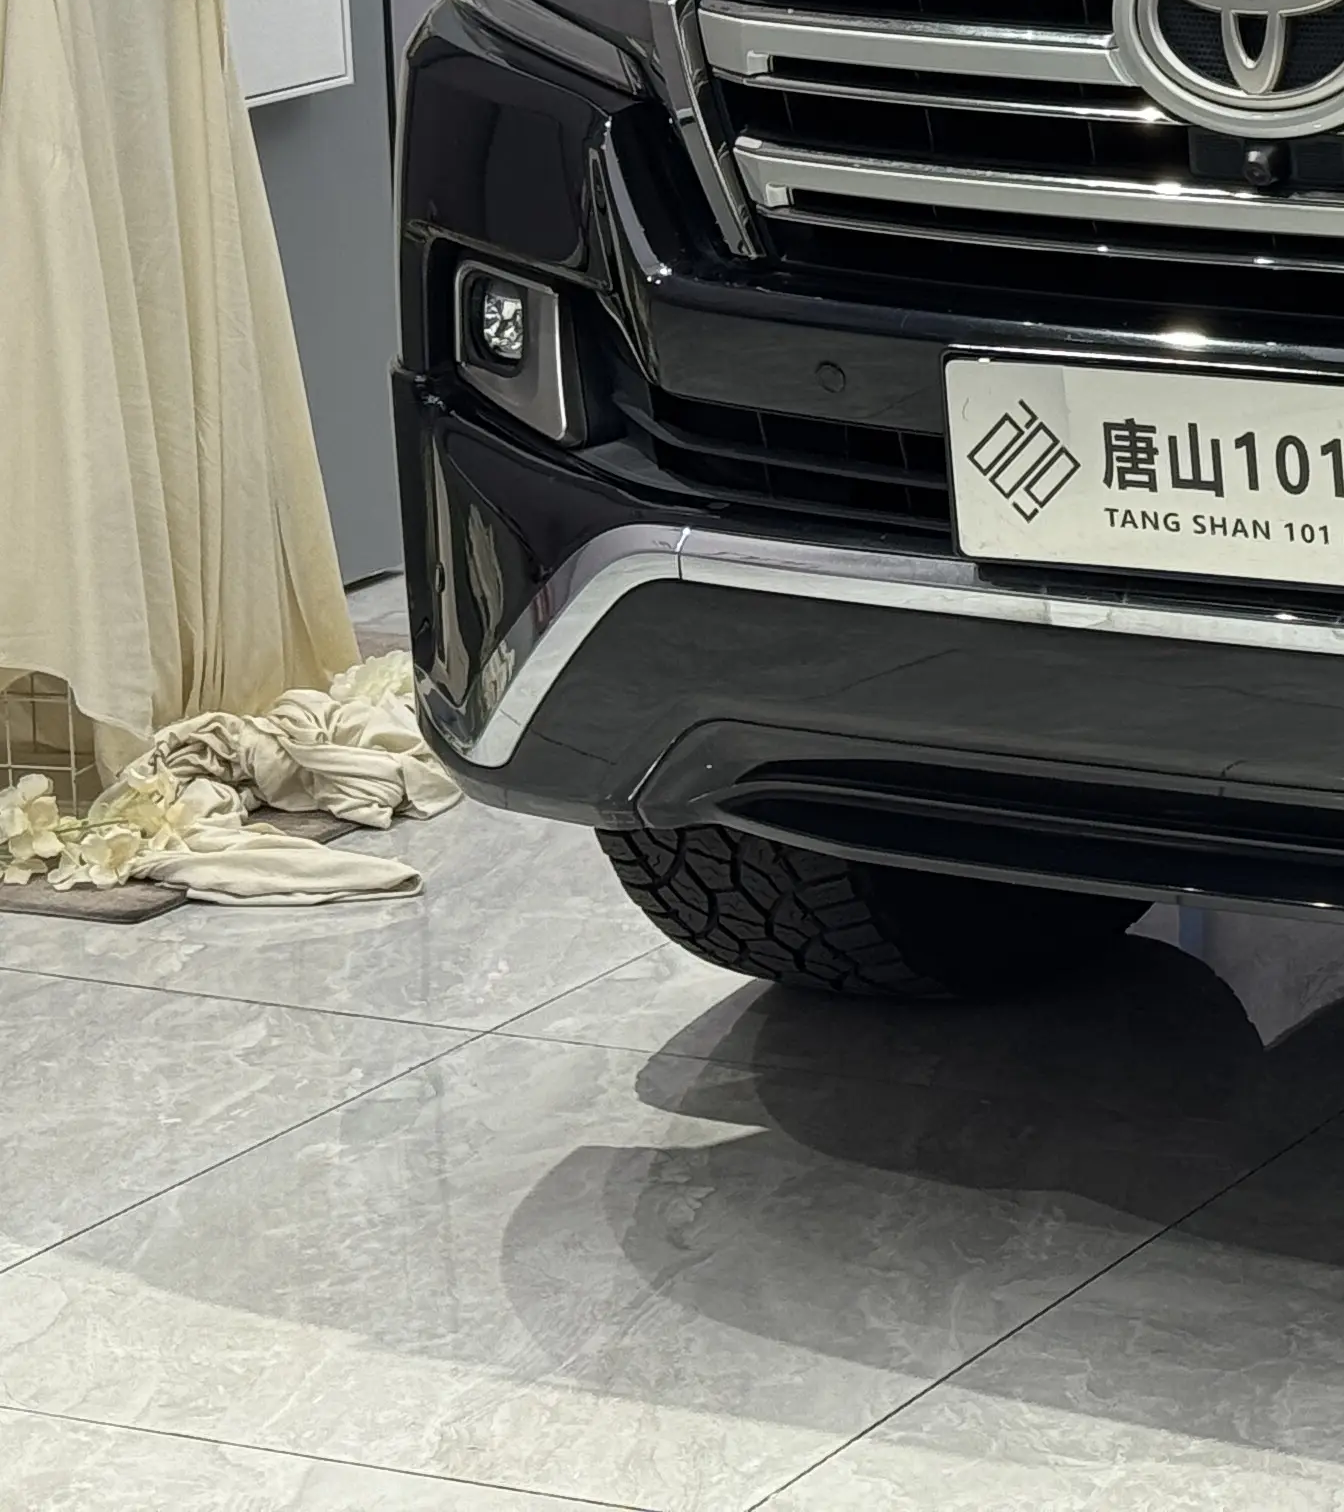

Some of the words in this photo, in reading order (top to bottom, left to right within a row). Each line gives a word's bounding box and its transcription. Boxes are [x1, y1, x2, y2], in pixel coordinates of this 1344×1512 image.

[1103, 507, 1181, 533] TANG
[1192, 514, 1271, 540] SHAN
[1284, 522, 1329, 545] 101
